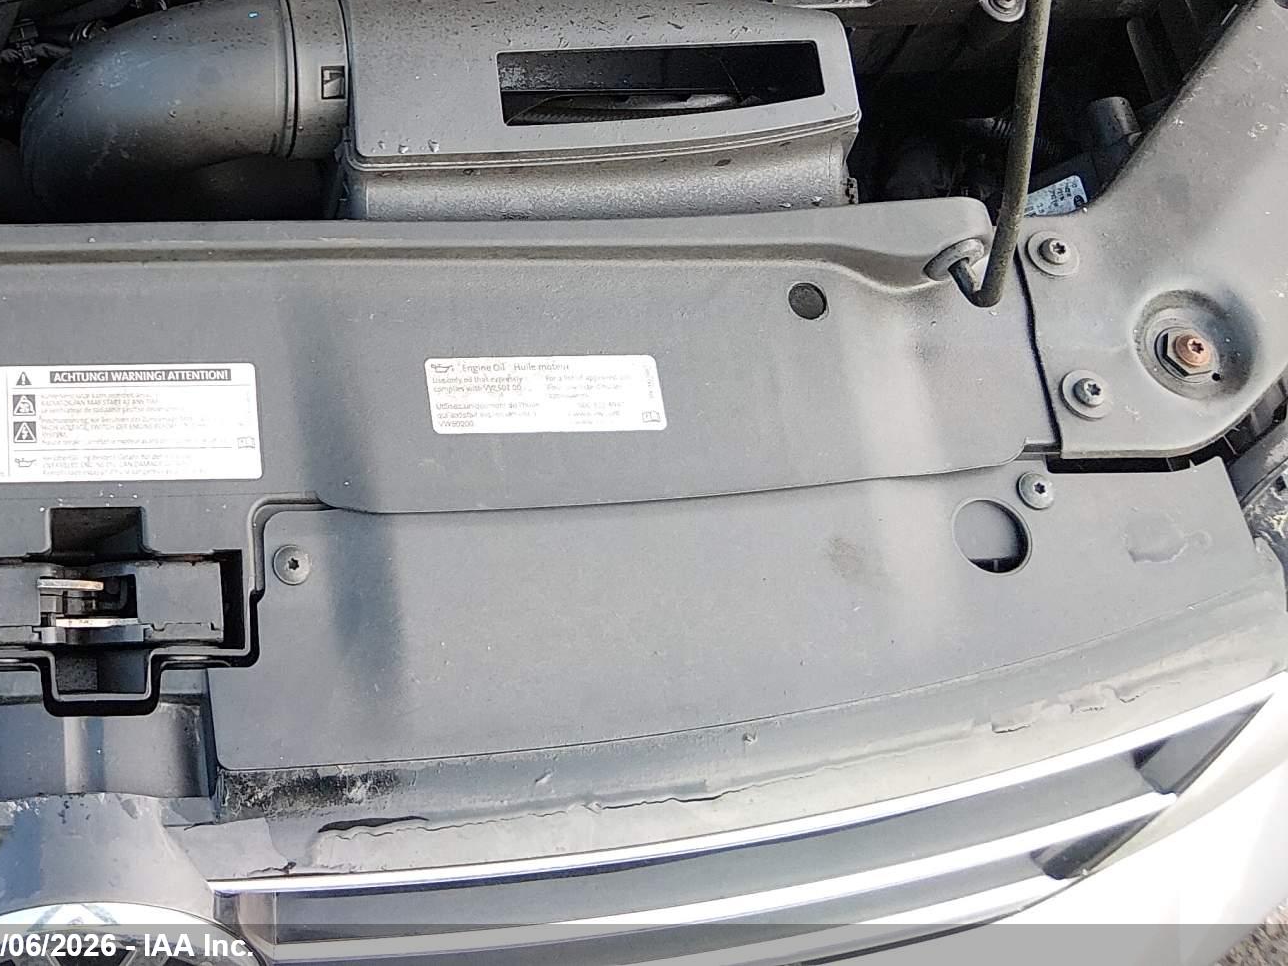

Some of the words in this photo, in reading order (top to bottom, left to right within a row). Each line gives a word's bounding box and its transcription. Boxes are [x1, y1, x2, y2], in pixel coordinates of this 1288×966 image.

[53, 371, 109, 383] ACHTUNG!
[112, 370, 167, 382] WARNING!
[168, 369, 229, 382] ATTENTION!
